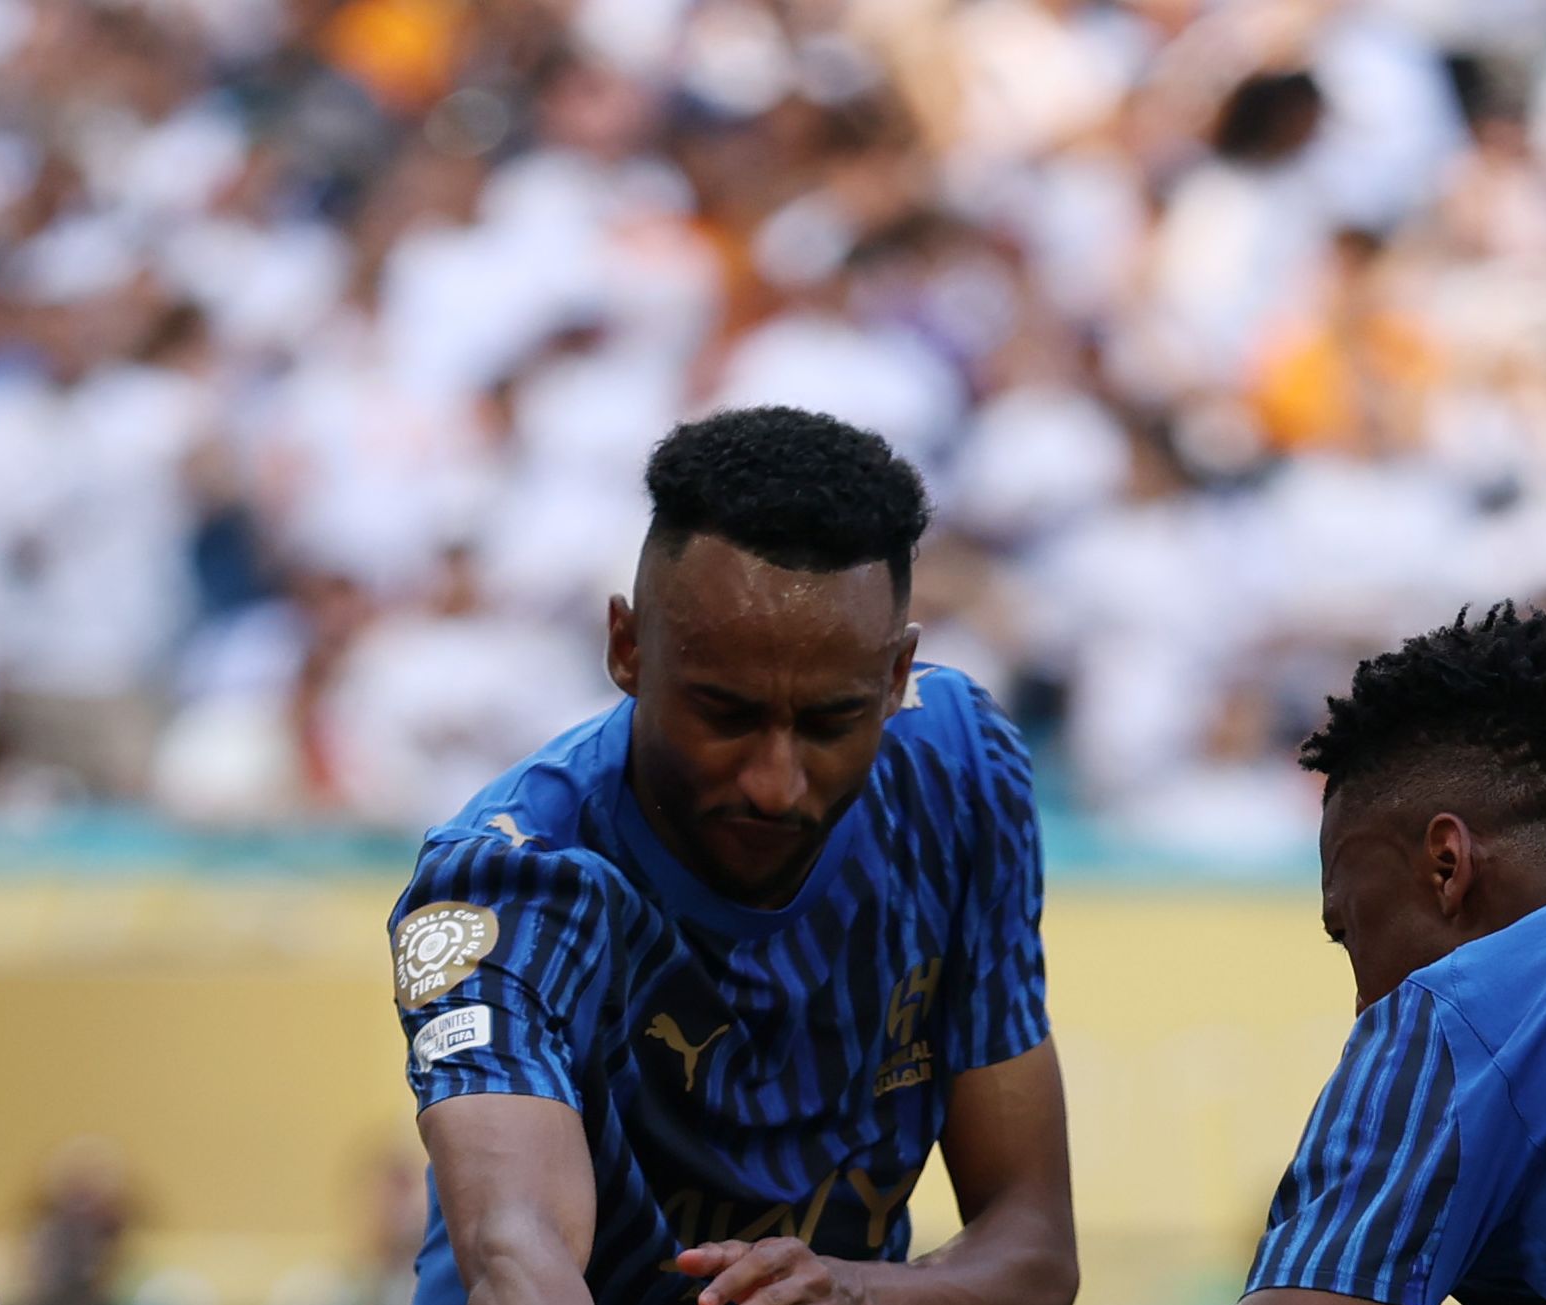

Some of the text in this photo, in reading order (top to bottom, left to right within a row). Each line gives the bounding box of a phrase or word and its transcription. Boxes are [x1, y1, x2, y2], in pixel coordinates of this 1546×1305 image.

[399, 910, 450, 948] WORLD
[410, 972, 447, 1001] FIFA
[438, 1011, 476, 1033] UNITES
[448, 1028, 476, 1048] FIFA
